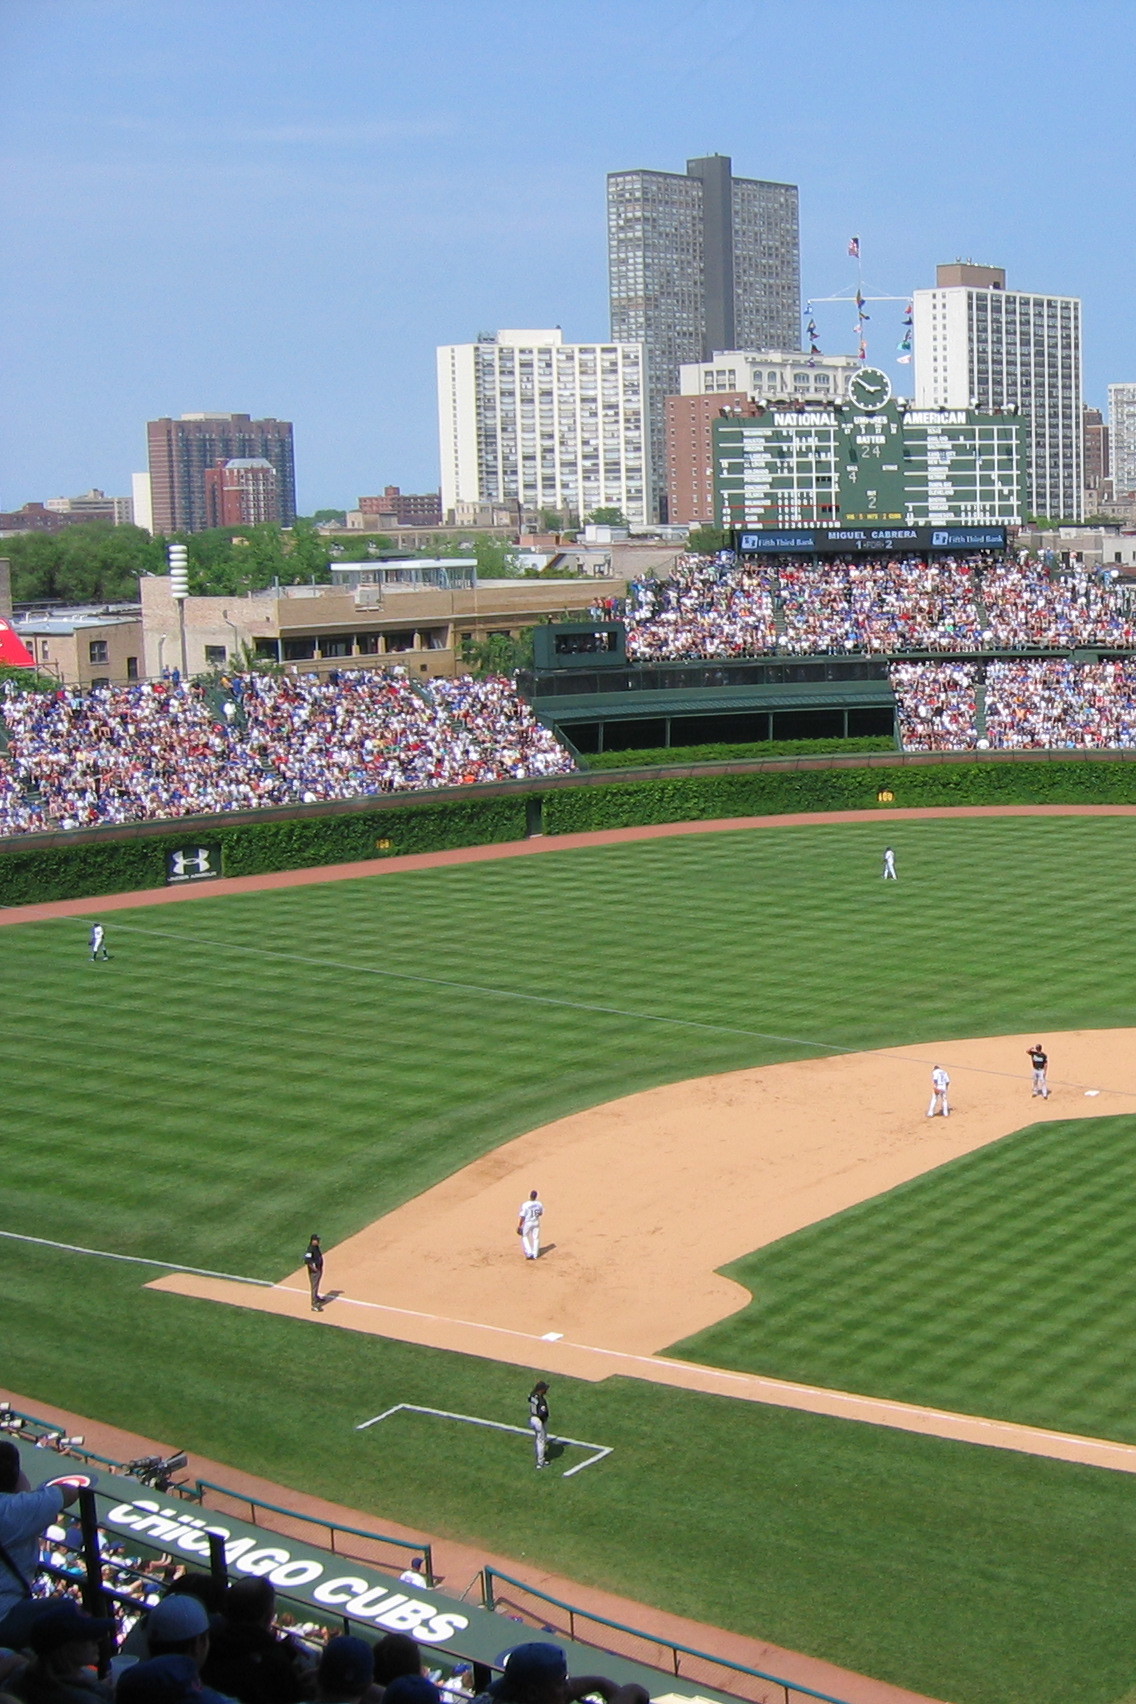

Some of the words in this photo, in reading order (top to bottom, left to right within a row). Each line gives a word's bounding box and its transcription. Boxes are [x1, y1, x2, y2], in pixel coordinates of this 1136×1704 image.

[774, 412, 838, 426] NATIONAL
[903, 412, 966, 424] AMERICAN
[856, 435, 886, 444] BATTER
[861, 445, 880, 458] 24
[848, 472, 856, 483] 4
[868, 496, 876, 508] 2
[828, 531, 866, 539] MIGUEL
[871, 530, 917, 538] CABRERA
[190, 871, 217, 879] ARMOUR
[107, 1500, 324, 1587] CHICAGO
[313, 1577, 468, 1643] CUBS
